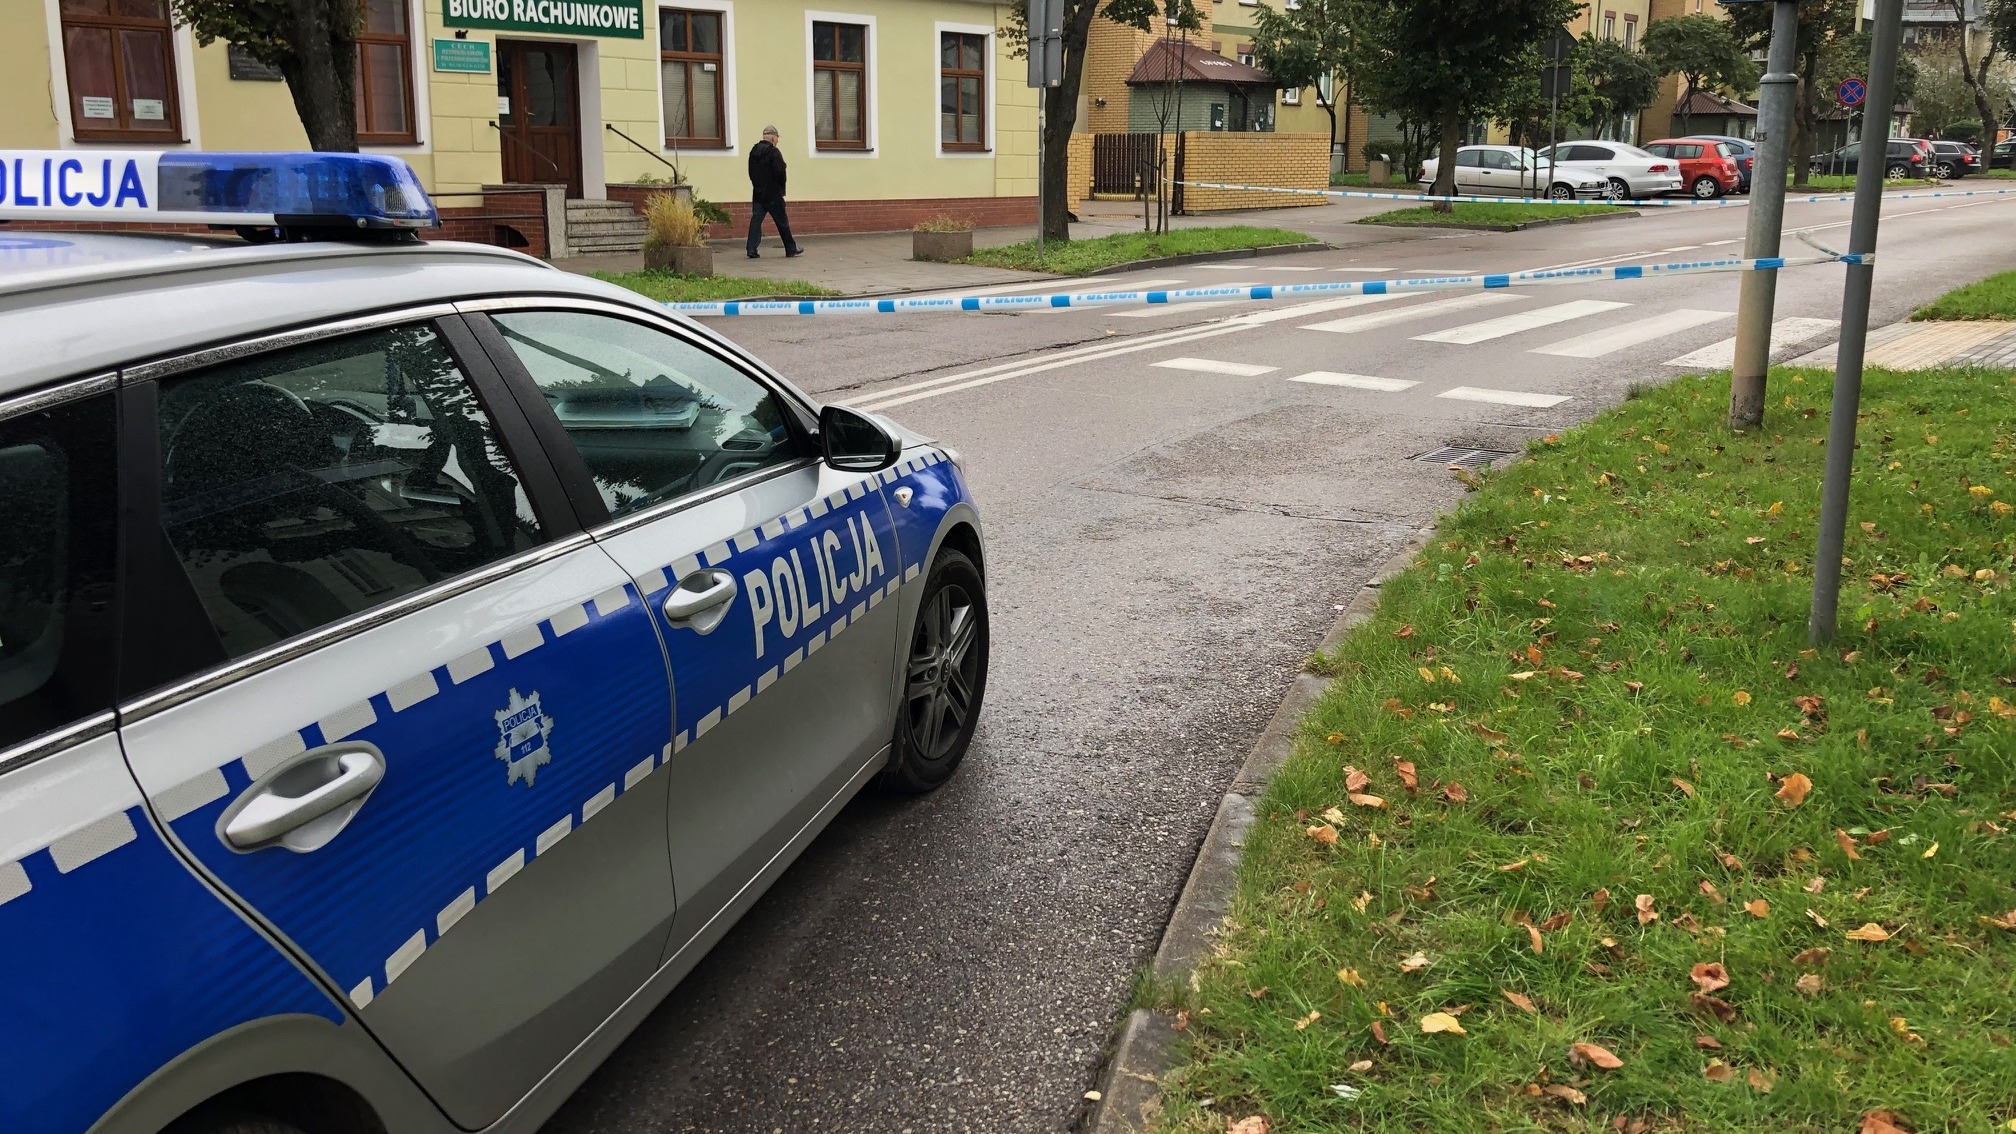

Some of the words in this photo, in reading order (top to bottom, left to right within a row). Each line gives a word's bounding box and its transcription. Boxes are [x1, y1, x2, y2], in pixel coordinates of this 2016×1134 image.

[450, 0, 509, 21] BIURO
[513, 0, 640, 30] RACHUNKOWE
[0, 158, 149, 208] LICJA
[743, 510, 885, 660] POLICJA
[503, 706, 538, 732] POLICJA
[521, 742, 532, 755] 112
